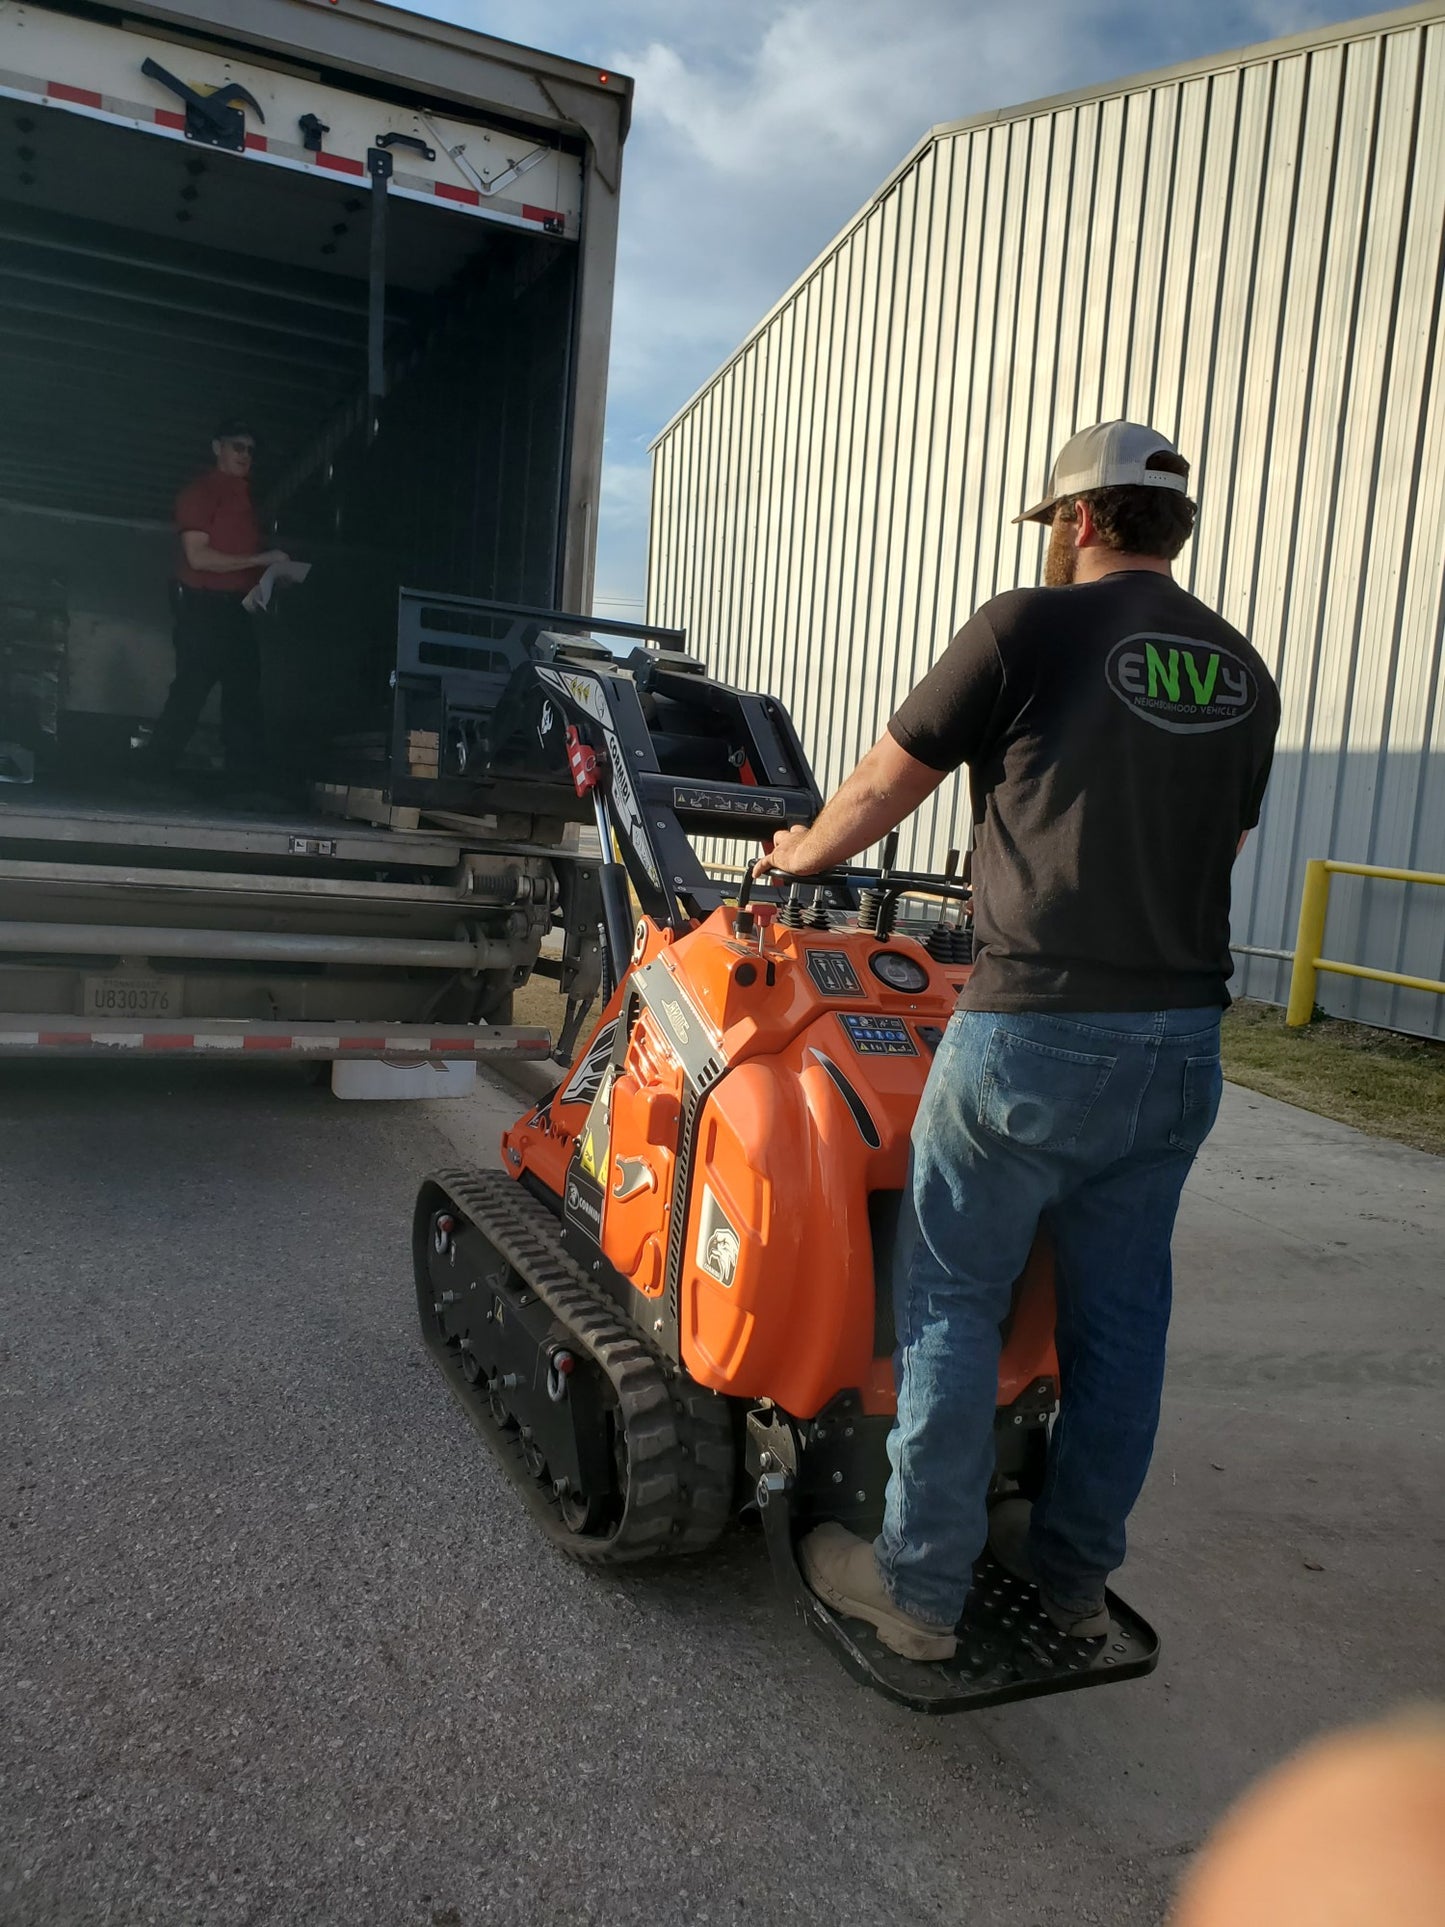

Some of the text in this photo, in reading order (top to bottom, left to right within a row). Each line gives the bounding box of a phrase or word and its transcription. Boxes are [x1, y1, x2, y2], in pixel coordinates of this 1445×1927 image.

[1200, 705, 1238, 717] VEHICLE
[609, 736, 631, 803] CORMIDI
[94, 988, 169, 1010] U830376
